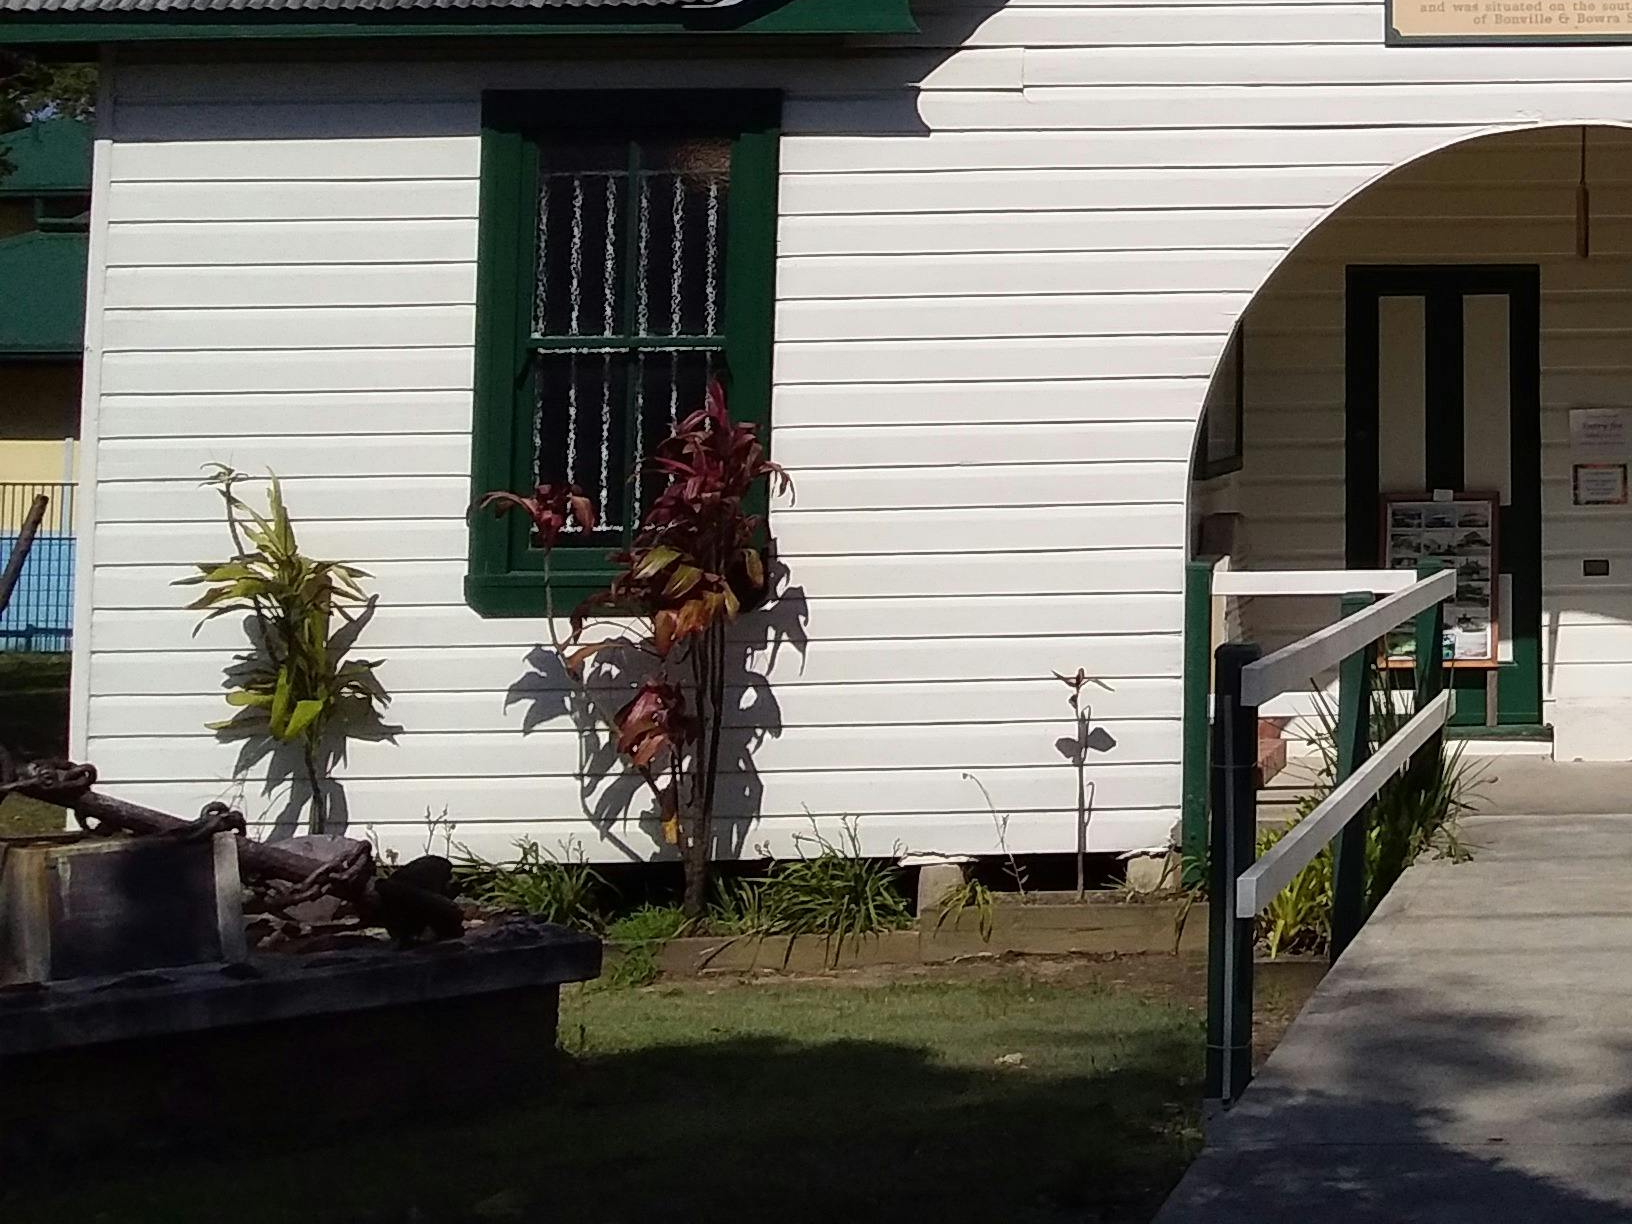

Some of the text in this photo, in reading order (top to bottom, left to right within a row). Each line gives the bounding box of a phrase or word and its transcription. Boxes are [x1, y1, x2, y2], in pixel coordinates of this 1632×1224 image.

[1420, 1, 1445, 12] and
[1453, 3, 1478, 12] was
[1486, 0, 1542, 11] situated
[1549, 3, 1566, 11] on
[1573, 0, 1595, 11] the
[1473, 14, 1487, 24] of
[1495, 13, 1552, 24] Bonville
[1577, 13, 1620, 23] Bowra
